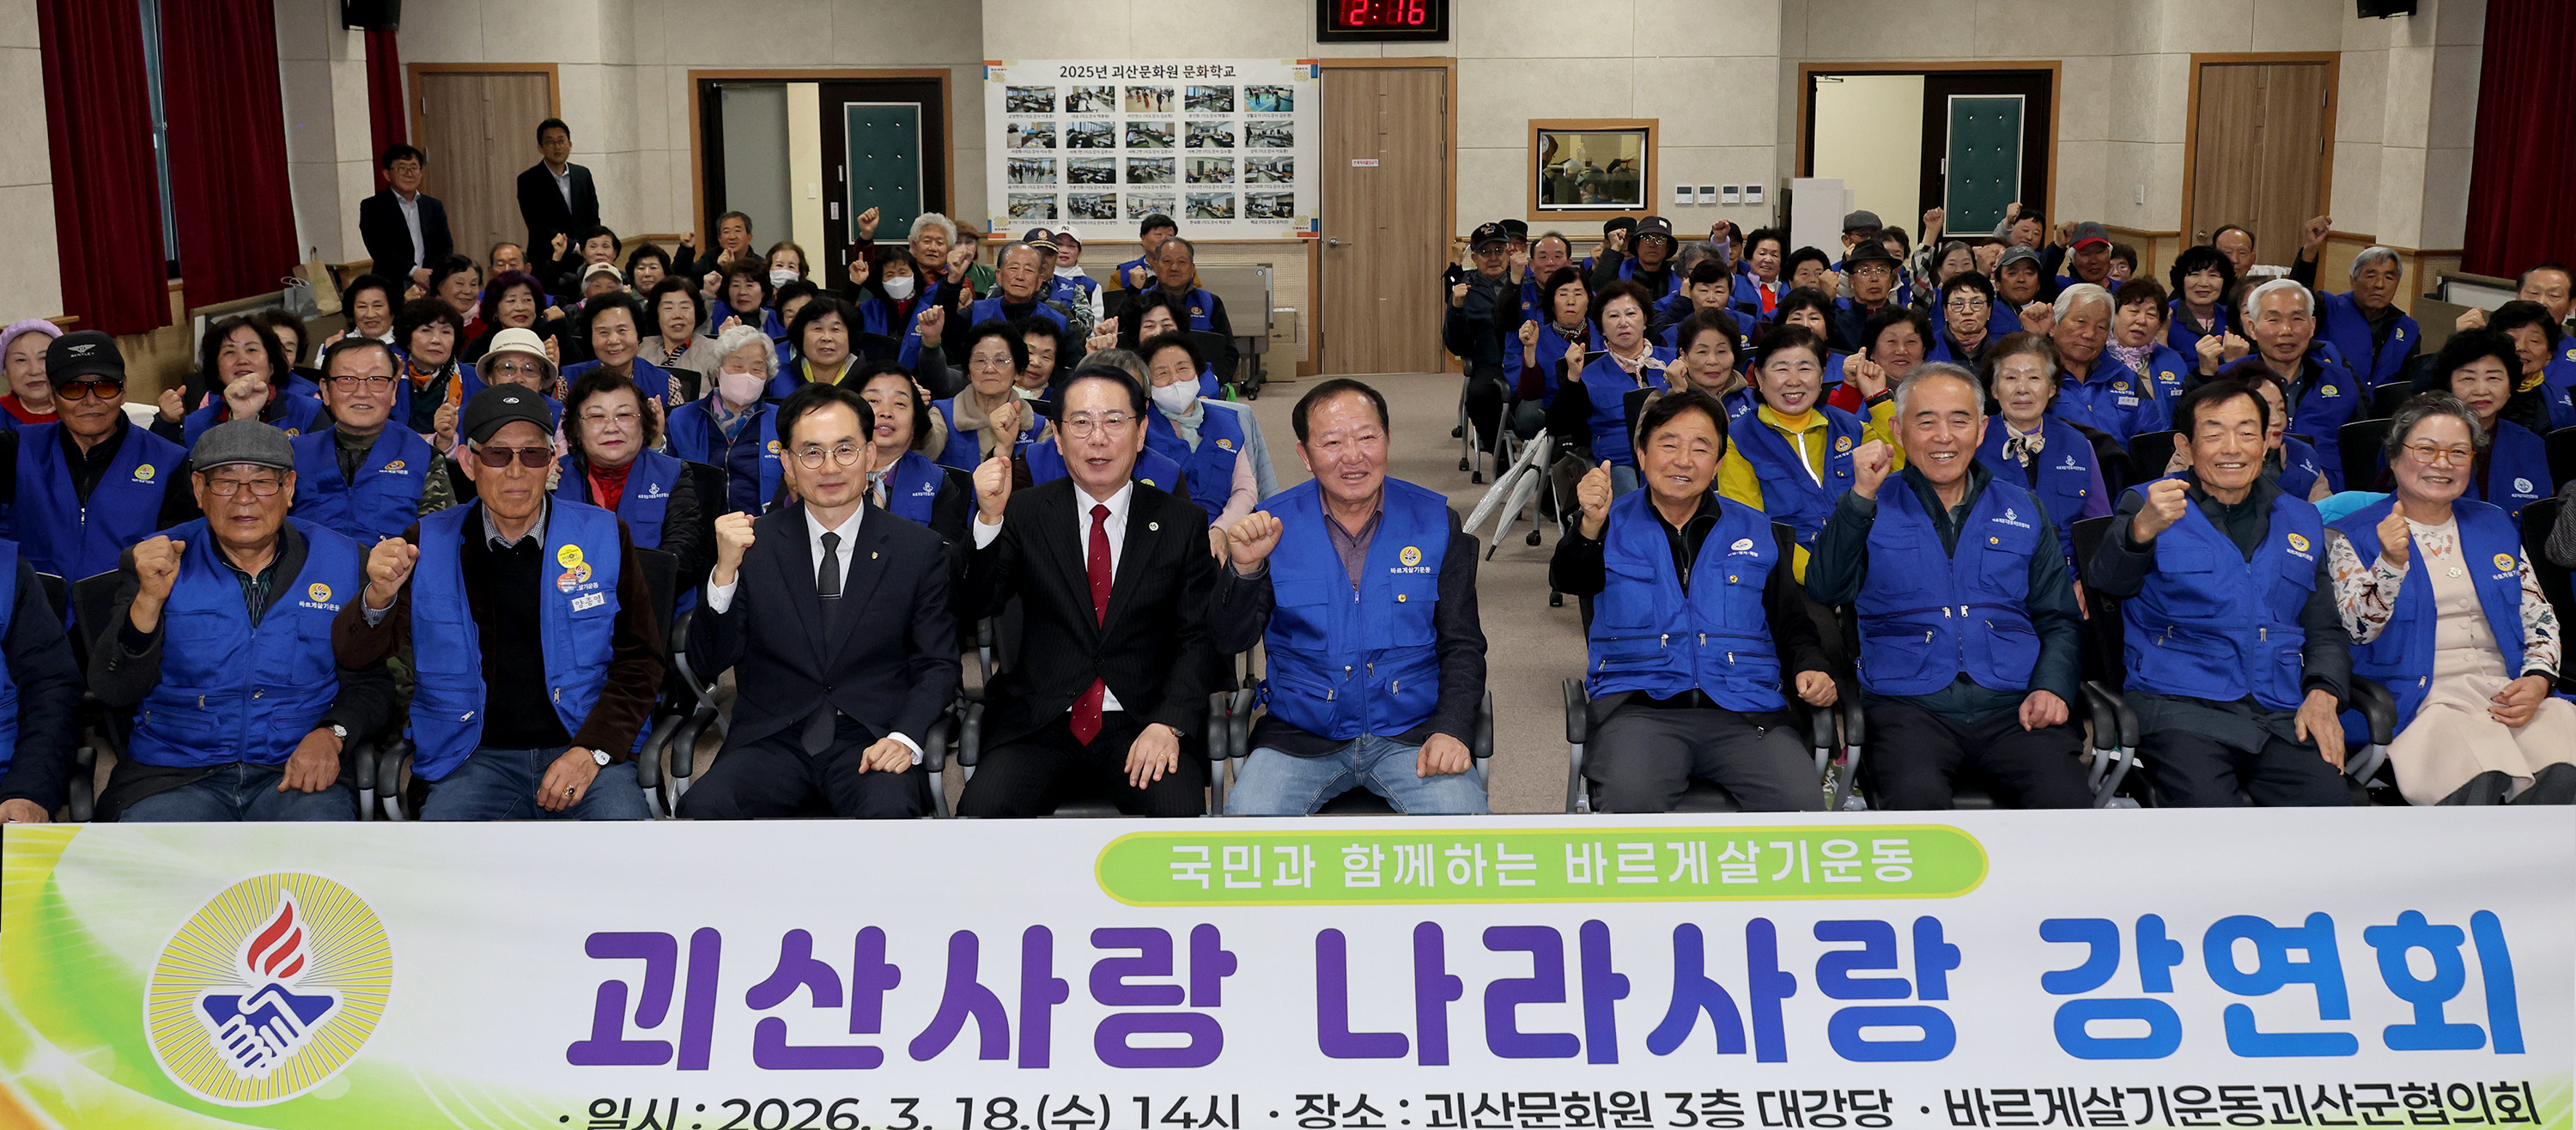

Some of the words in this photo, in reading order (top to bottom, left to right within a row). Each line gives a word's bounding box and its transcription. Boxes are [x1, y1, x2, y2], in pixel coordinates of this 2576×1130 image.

[1060, 65, 1108, 79] 2025년
[1112, 65, 1178, 79] 괴산문화원
[1182, 65, 1236, 79] 문화학교
[1170, 846, 1317, 890] 국민과
[1341, 842, 1538, 889] 함께하는
[1565, 838, 1915, 887] 바르게살기운동
[566, 924, 1238, 1071] 괴산사랑
[1315, 916, 1962, 1066] 나라사랑
[2039, 909, 2526, 1061] 강연회
[588, 1098, 679, 1130] 일시
[720, 1098, 871, 1130] 2026.
[887, 1098, 933, 1130] 3.
[1133, 1096, 1241, 1130] 14시
[1297, 1094, 1388, 1130] 장소
[1425, 1092, 1655, 1130] 괴산문화원
[1666, 1090, 1746, 1129] 3층
[1757, 1089, 1894, 1129] 대강당
[1945, 1082, 2543, 1128] 바르게살기운동괴산군협의회
